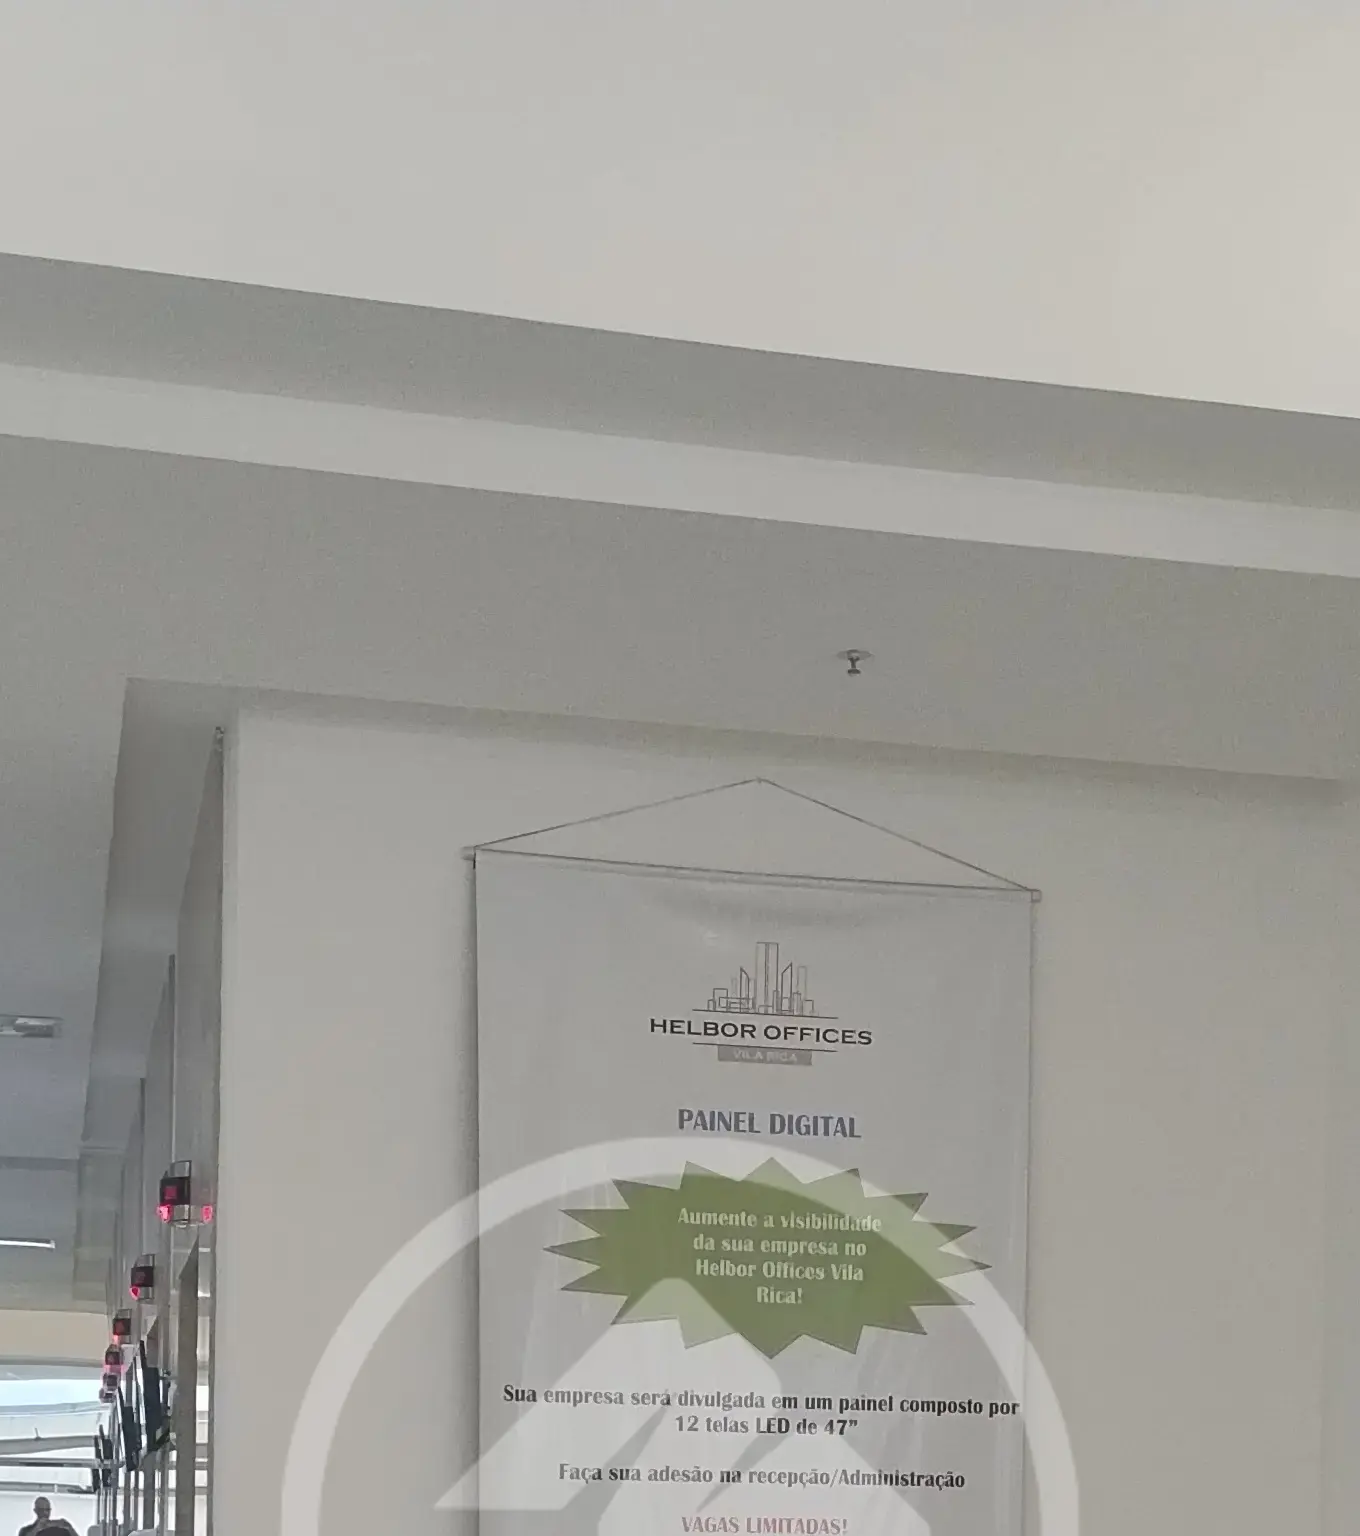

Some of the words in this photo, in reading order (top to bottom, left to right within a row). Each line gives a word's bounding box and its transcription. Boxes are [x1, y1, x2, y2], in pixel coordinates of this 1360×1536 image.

[650, 1018, 757, 1039] HELBOR
[763, 1024, 873, 1046] OFFICES
[733, 1049, 764, 1061] VILA
[677, 1108, 761, 1134] PAINEL
[769, 1112, 862, 1139] DIGITAL
[677, 1207, 758, 1228] Aumente
[763, 1214, 775, 1228] a
[780, 1210, 883, 1232] visibilidade
[693, 1233, 716, 1251] da
[721, 1237, 755, 1252] sua
[760, 1239, 839, 1257] empresa
[844, 1242, 868, 1256] no
[695, 1258, 757, 1278] Helbor
[762, 1260, 825, 1280] Offices
[830, 1263, 865, 1281] Vila
[756, 1286, 804, 1304] Rica!
[503, 1384, 538, 1403] Sua
[543, 1388, 625, 1407] empresa
[630, 1388, 672, 1406] será
[677, 1389, 766, 1411] divulgada
[771, 1395, 798, 1410] em
[804, 1396, 833, 1411] um
[839, 1394, 894, 1414] painel
[899, 1397, 983, 1417] composto
[988, 1401, 1022, 1418] por
[675, 1415, 700, 1432] 12
[705, 1416, 749, 1434] telas
[755, 1417, 790, 1434] LED
[796, 1418, 818, 1435] de
[558, 1463, 603, 1484] Faça
[608, 1466, 642, 1482] sua
[647, 1465, 713, 1483] adesão
[719, 1469, 742, 1484] na
[748, 1468, 966, 1491] recepção/Administração
[681, 1516, 740, 1533] VAGAS
[746, 1516, 848, 1536] LIMITADAS!
